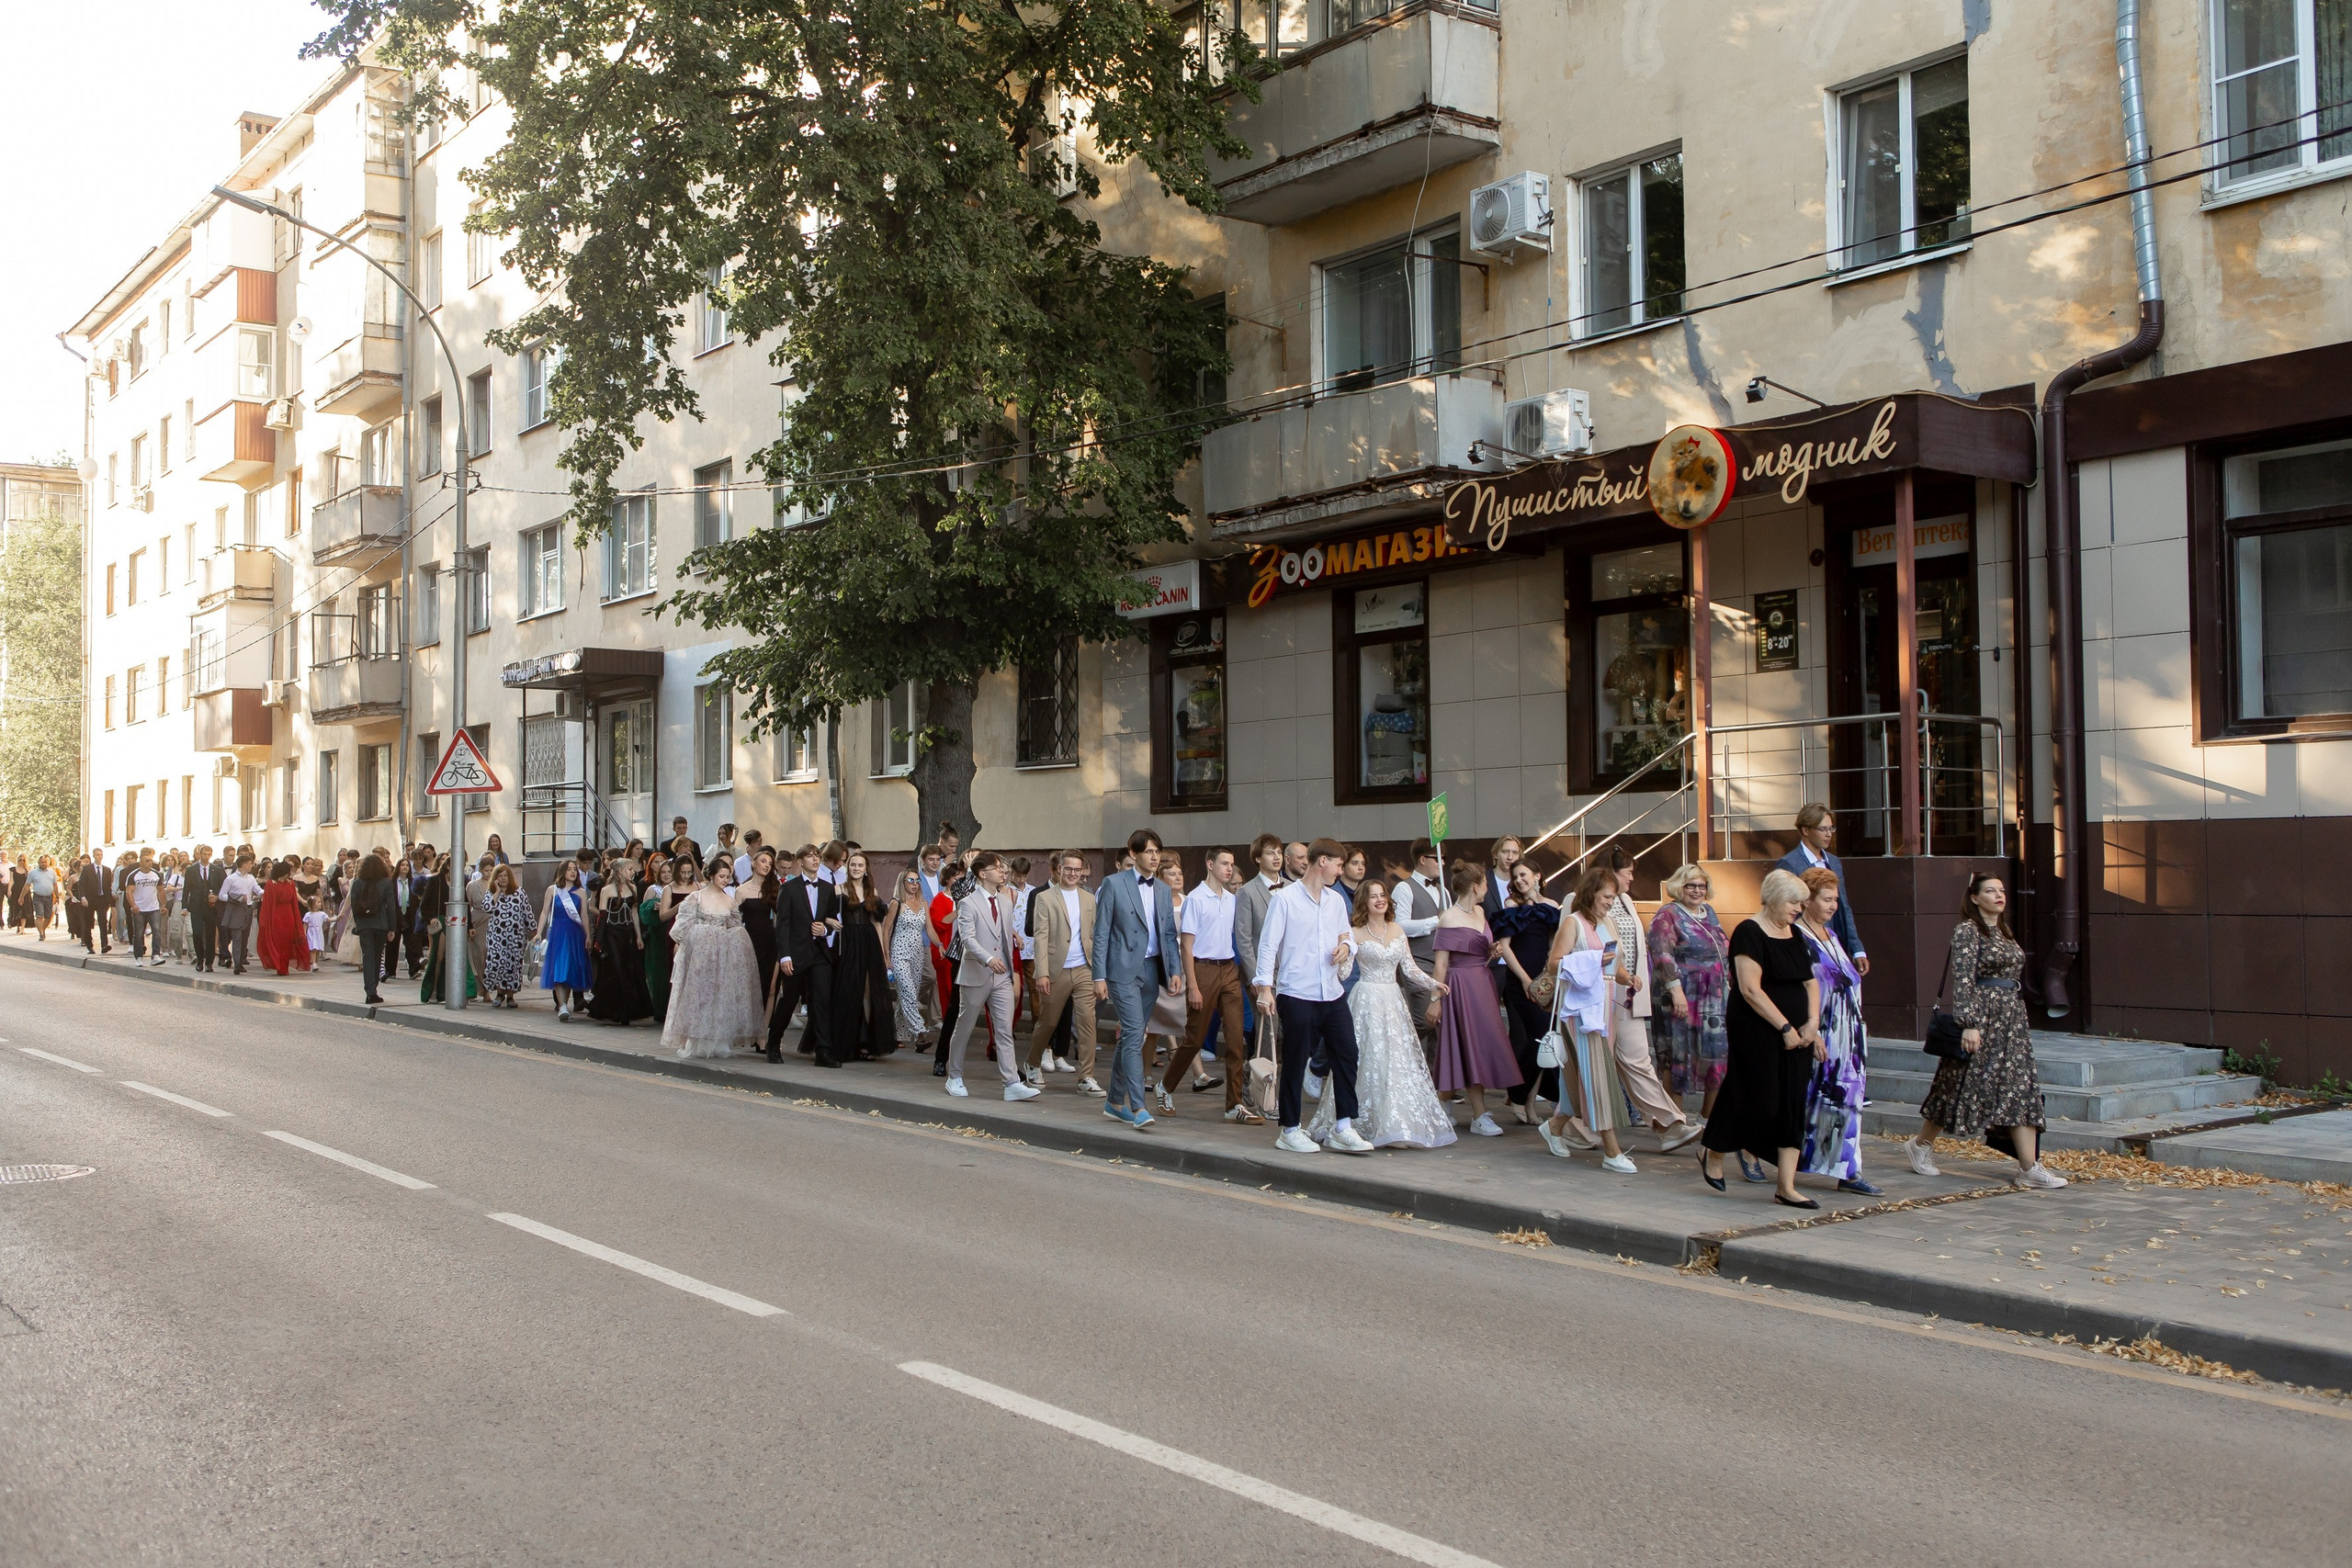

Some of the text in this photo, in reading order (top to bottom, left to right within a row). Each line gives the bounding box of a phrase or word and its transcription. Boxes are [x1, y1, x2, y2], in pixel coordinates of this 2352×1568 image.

[1445, 401, 1897, 551] Пушистый модник
[1155, 587, 1188, 606] CANIN
